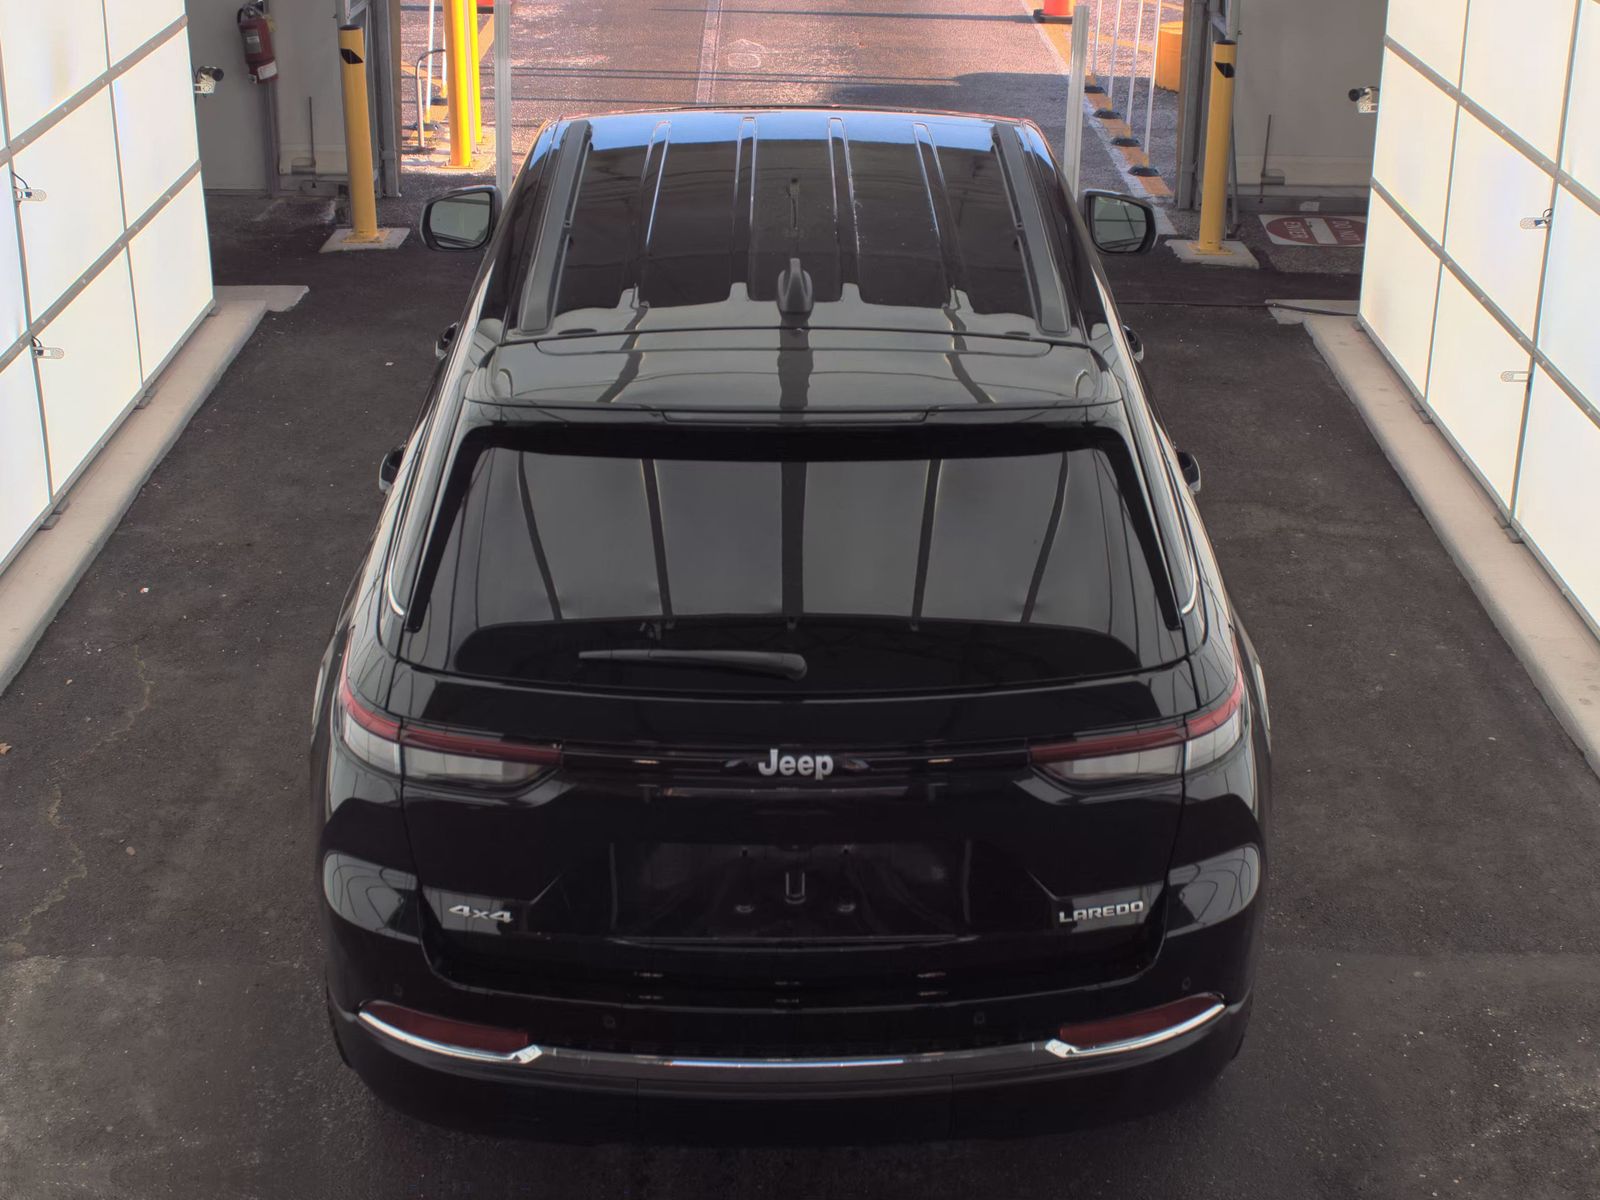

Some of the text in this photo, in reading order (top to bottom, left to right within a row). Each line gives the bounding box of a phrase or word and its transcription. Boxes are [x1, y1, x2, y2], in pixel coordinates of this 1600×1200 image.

[757, 748, 834, 780] Jeep
[448, 904, 513, 923] 4x4
[1058, 900, 1144, 923] LAREDO
